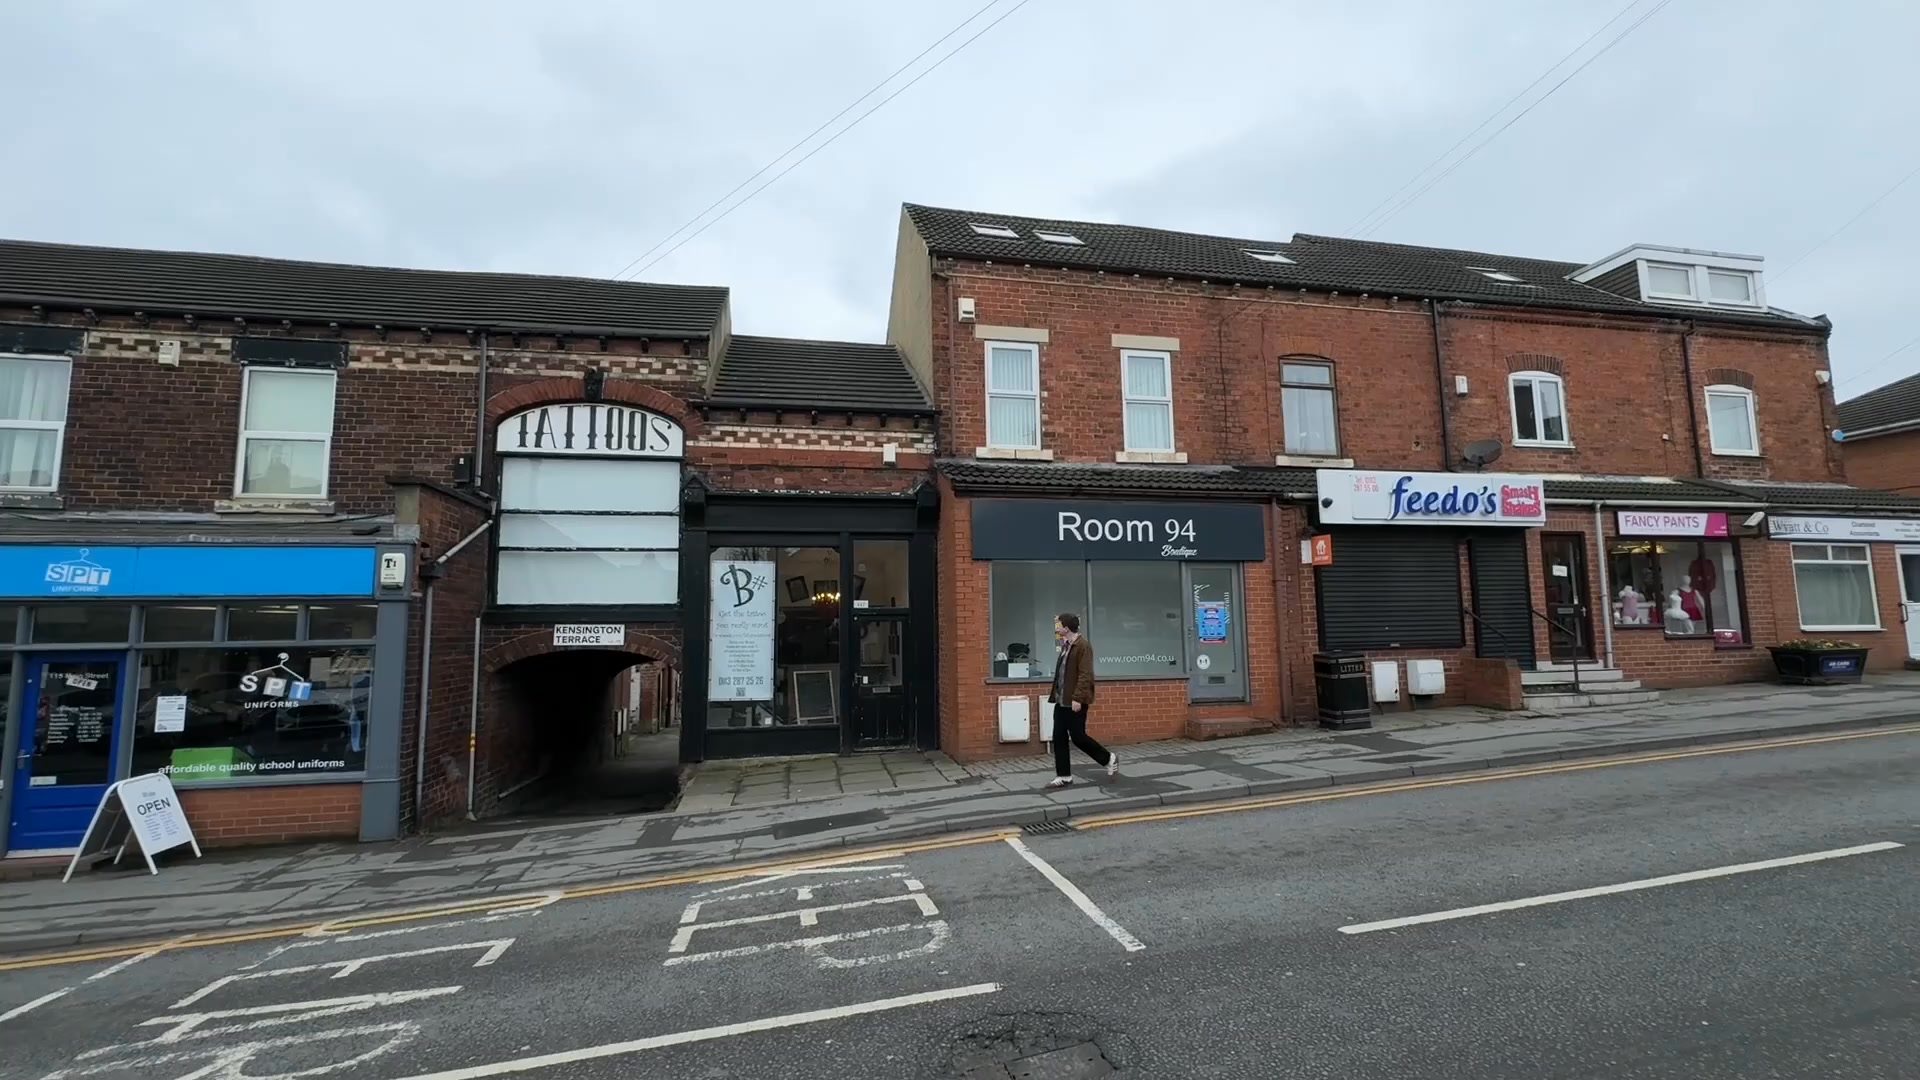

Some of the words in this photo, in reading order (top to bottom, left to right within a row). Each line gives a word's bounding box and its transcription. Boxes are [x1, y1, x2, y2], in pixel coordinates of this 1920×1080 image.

[514, 404, 672, 452] TATTOOS
[1389, 475, 1497, 521] feedo's
[1057, 511, 1154, 542] Room
[1164, 518, 1197, 543] 94
[1624, 515, 1660, 528] FANCY
[1663, 516, 1700, 529] PANTS
[1803, 521, 1813, 533] &
[1815, 521, 1829, 533] Co
[47, 565, 109, 585] SPT
[555, 625, 622, 635] KENSINGTON
[555, 635, 601, 645] TERRACE
[239, 674, 311, 700] SPT
[244, 700, 299, 709] UNIFORMS
[158, 762, 216, 774] affordable
[218, 761, 257, 773] quality
[258, 759, 295, 771] school
[297, 758, 345, 769] uniforms
[136, 796, 171, 816] OPEN
